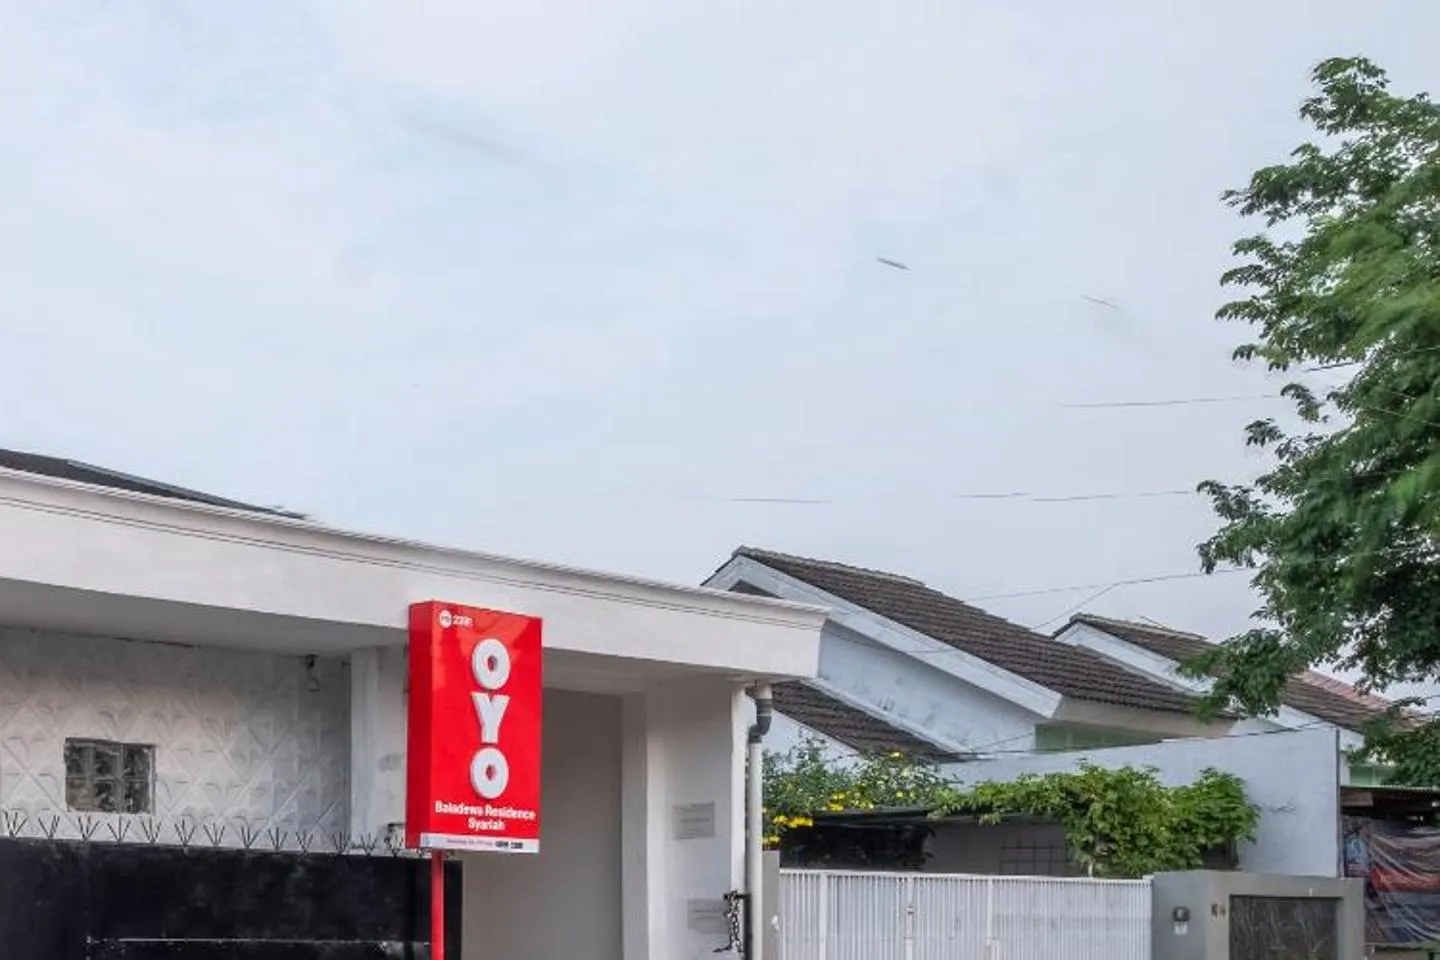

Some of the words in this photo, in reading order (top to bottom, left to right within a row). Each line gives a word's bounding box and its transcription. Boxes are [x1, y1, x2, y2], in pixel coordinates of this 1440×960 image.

[471, 638, 511, 800] OYO
[435, 801, 482, 815] Baladewa
[485, 804, 536, 820] Residence
[467, 817, 505, 831] Syariah
